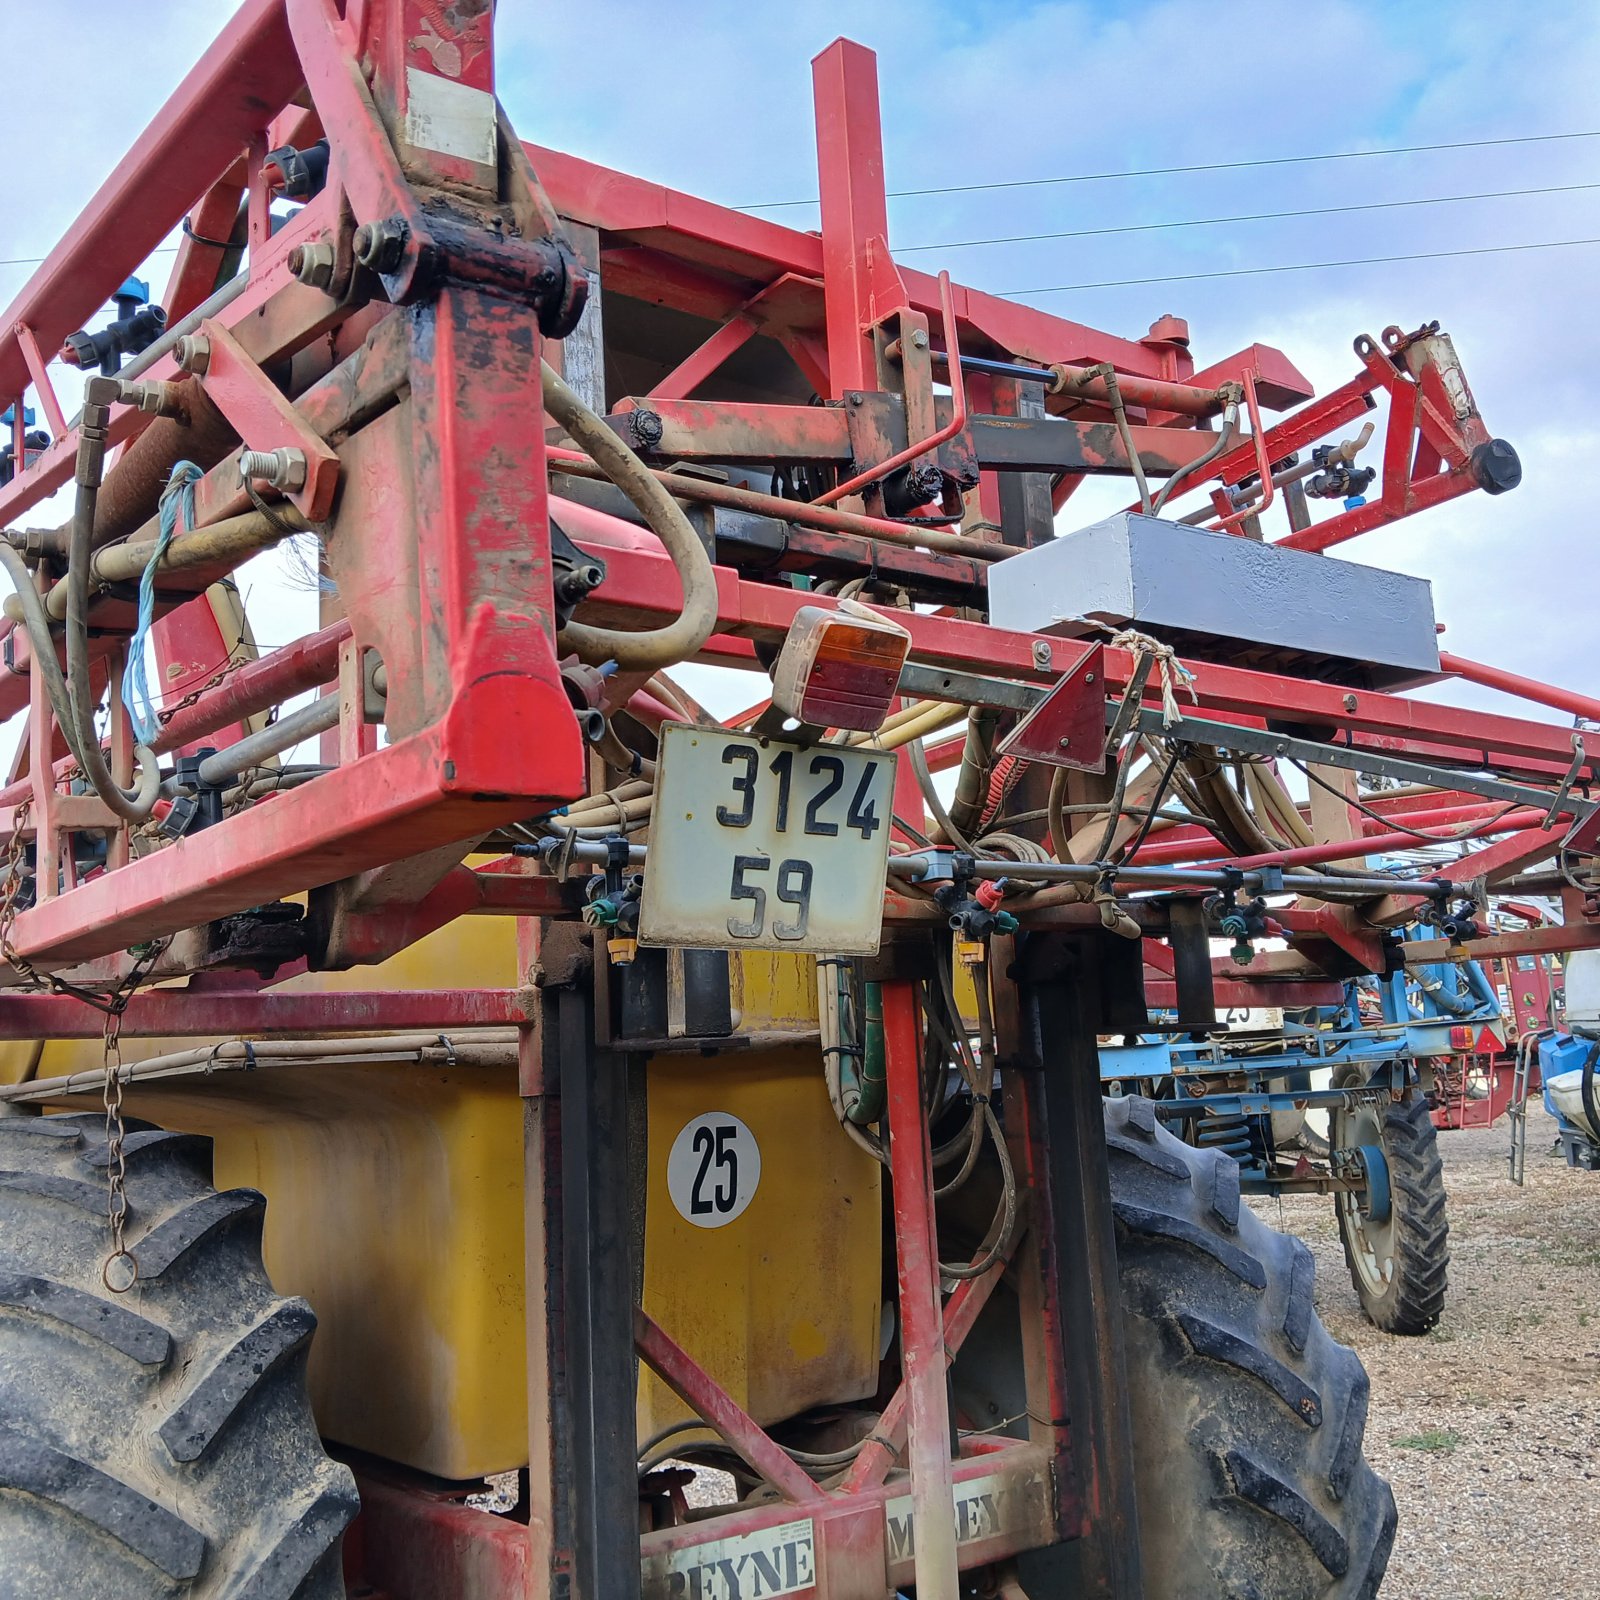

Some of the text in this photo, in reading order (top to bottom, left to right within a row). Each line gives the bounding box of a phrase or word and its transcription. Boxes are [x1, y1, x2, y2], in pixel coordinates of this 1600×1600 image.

[716, 744, 880, 840] 3124
[727, 855, 814, 940] 59
[691, 1126, 738, 1215] 25
